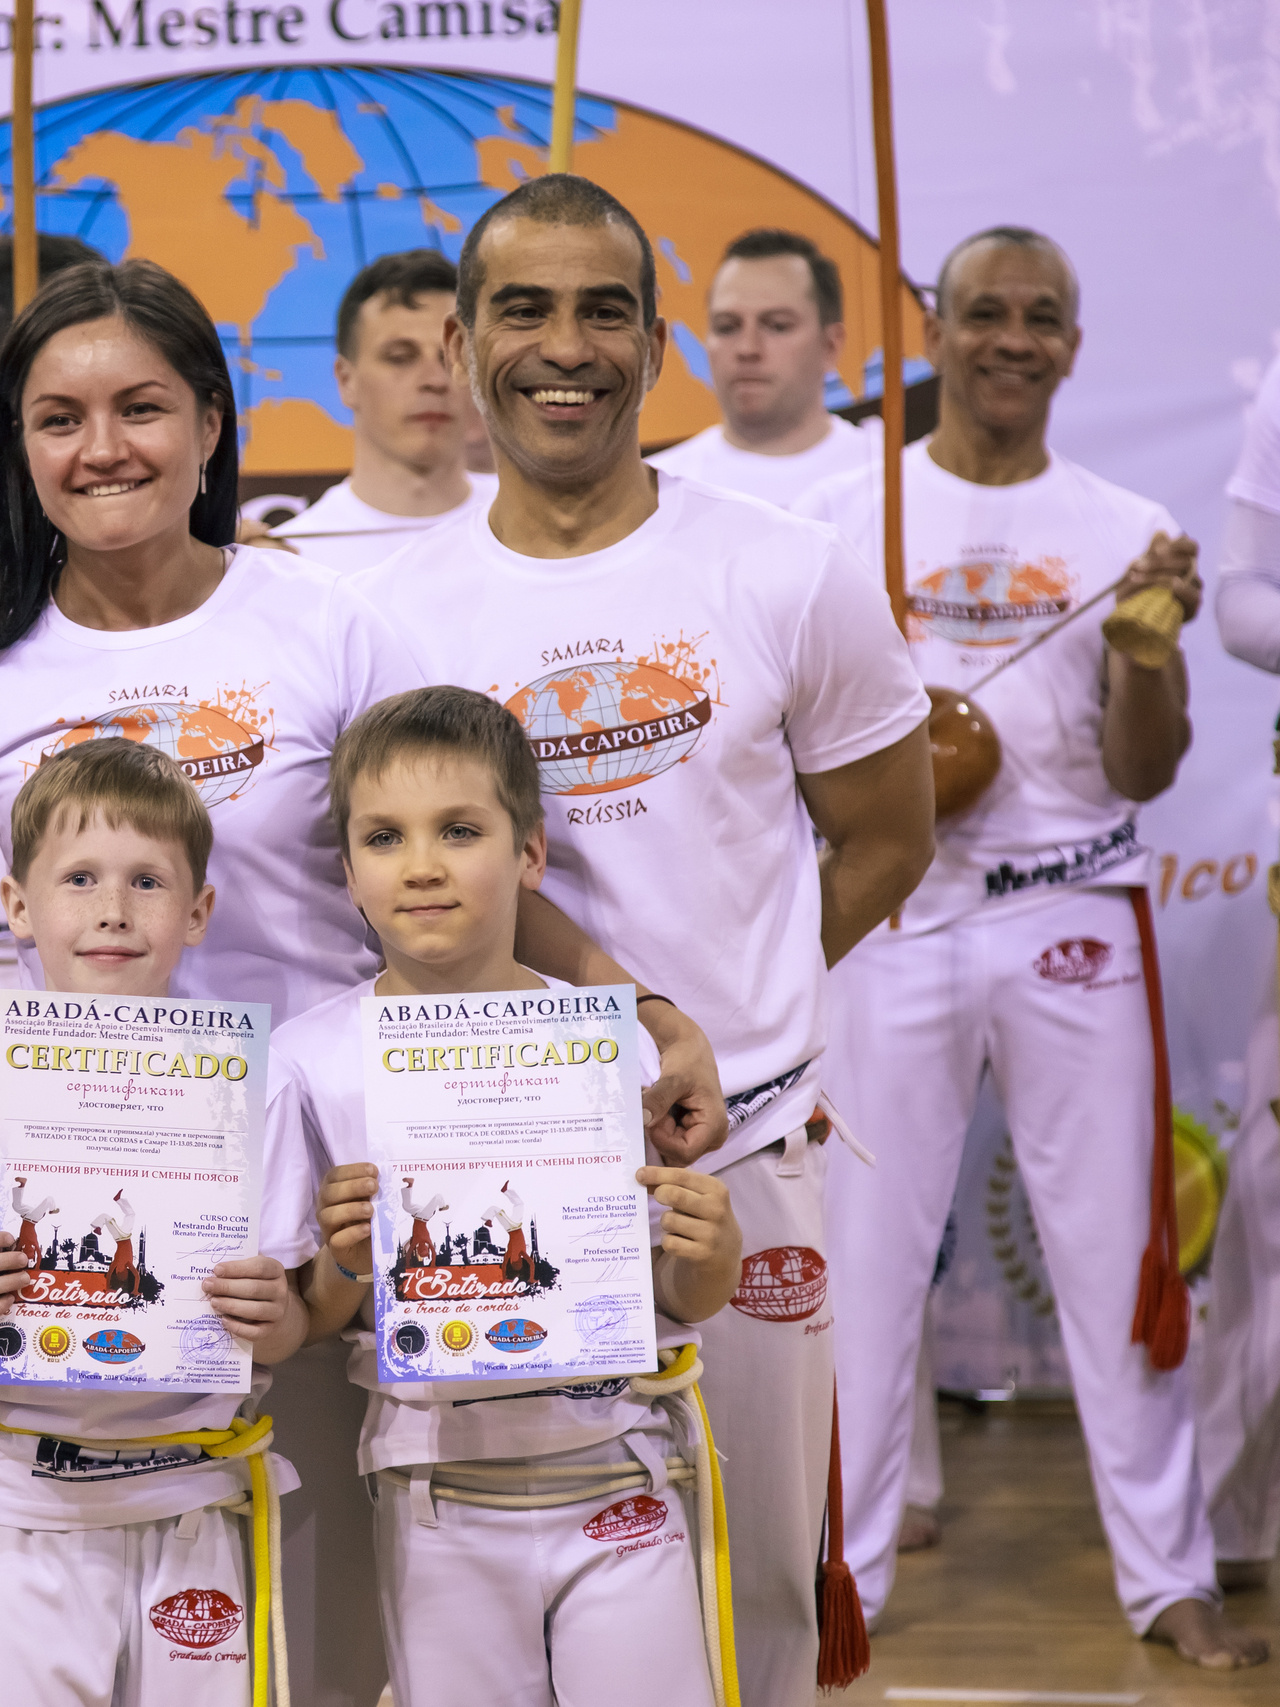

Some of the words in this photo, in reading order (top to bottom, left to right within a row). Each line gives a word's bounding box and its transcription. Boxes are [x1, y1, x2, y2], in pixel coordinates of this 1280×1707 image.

[88, 0, 303, 49] Mestre
[541, 638, 625, 666] SAMARA
[108, 684, 189, 704] SAMARA
[531, 711, 700, 759] DÁ-CAPOEIRA
[567, 798, 648, 825] RÚSSIA
[6, 999, 253, 1029] ABADÁ-CAPOEIRA
[378, 996, 620, 1023] ABADÁ-CAPOEIRA
[4, 1025, 50, 1036] Presidente
[52, 1027, 97, 1038] Fundador:
[99, 1030, 129, 1040] Mestre
[131, 1032, 163, 1042] Camisa
[378, 1031, 423, 1040] Presidente
[425, 1028, 468, 1038] Fundador:
[470, 1027, 500, 1036] Mestre
[501, 1025, 533, 1035] Camisa
[6, 1043, 248, 1081] CERTIFICADO
[382, 1038, 619, 1073] CERTIFICADO
[66, 1078, 185, 1101] сертификат
[443, 1071, 560, 1096] сертификат
[13, 1162, 80, 1174] ЦЕРЕМОНИЯ
[83, 1166, 138, 1177] ВРУЧЕНИЯ
[151, 1170, 191, 1180] СМЕНЫ
[193, 1172, 238, 1182] ПОЯСОВ
[399, 1161, 465, 1172] ЦЕРЕМОНИЯ
[468, 1159, 522, 1169] ВРУЧЕНИЯ
[535, 1157, 574, 1166] СМЕНЫ
[577, 1155, 621, 1164] ПОЯСОВ
[562, 1204, 603, 1213] Mestrando
[605, 1203, 636, 1211] Brucutu
[587, 1195, 615, 1203] CURSO
[173, 1220, 215, 1230] Mestrando
[217, 1222, 248, 1231] Brucutu
[199, 1213, 228, 1221] CURSO
[583, 1247, 619, 1255] Professor
[621, 1246, 639, 1254] Teco
[190, 1265, 215, 1273] Profes
[15, 1302, 52, 1318] troca
[54, 1309, 72, 1318] de
[75, 1311, 121, 1321] cordas
[415, 1299, 451, 1314] troca
[455, 1302, 472, 1313] de
[475, 1301, 520, 1312] cordas
[616, 1535, 662, 1557] Graduado
[170, 1650, 212, 1662] Graduado
